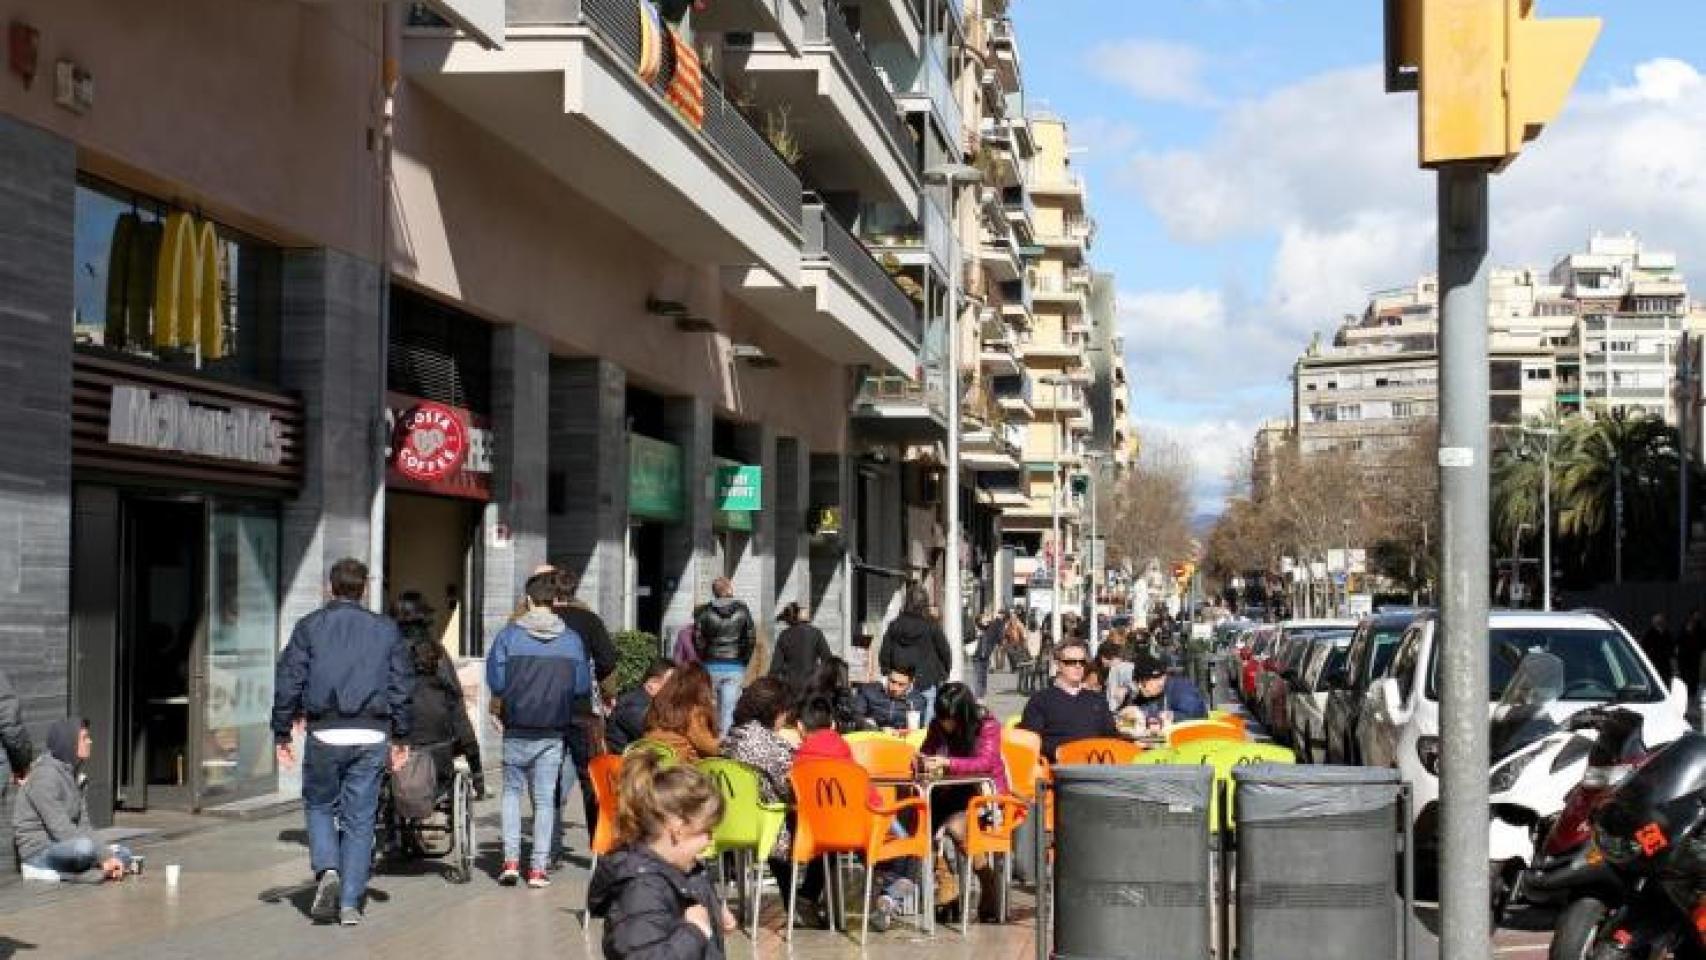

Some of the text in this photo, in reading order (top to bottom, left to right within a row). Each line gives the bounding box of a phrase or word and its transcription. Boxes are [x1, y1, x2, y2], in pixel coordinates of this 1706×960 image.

[404, 410, 451, 430] COSTA
[400, 445, 455, 472] COFFEE
[815, 777, 847, 809] M
